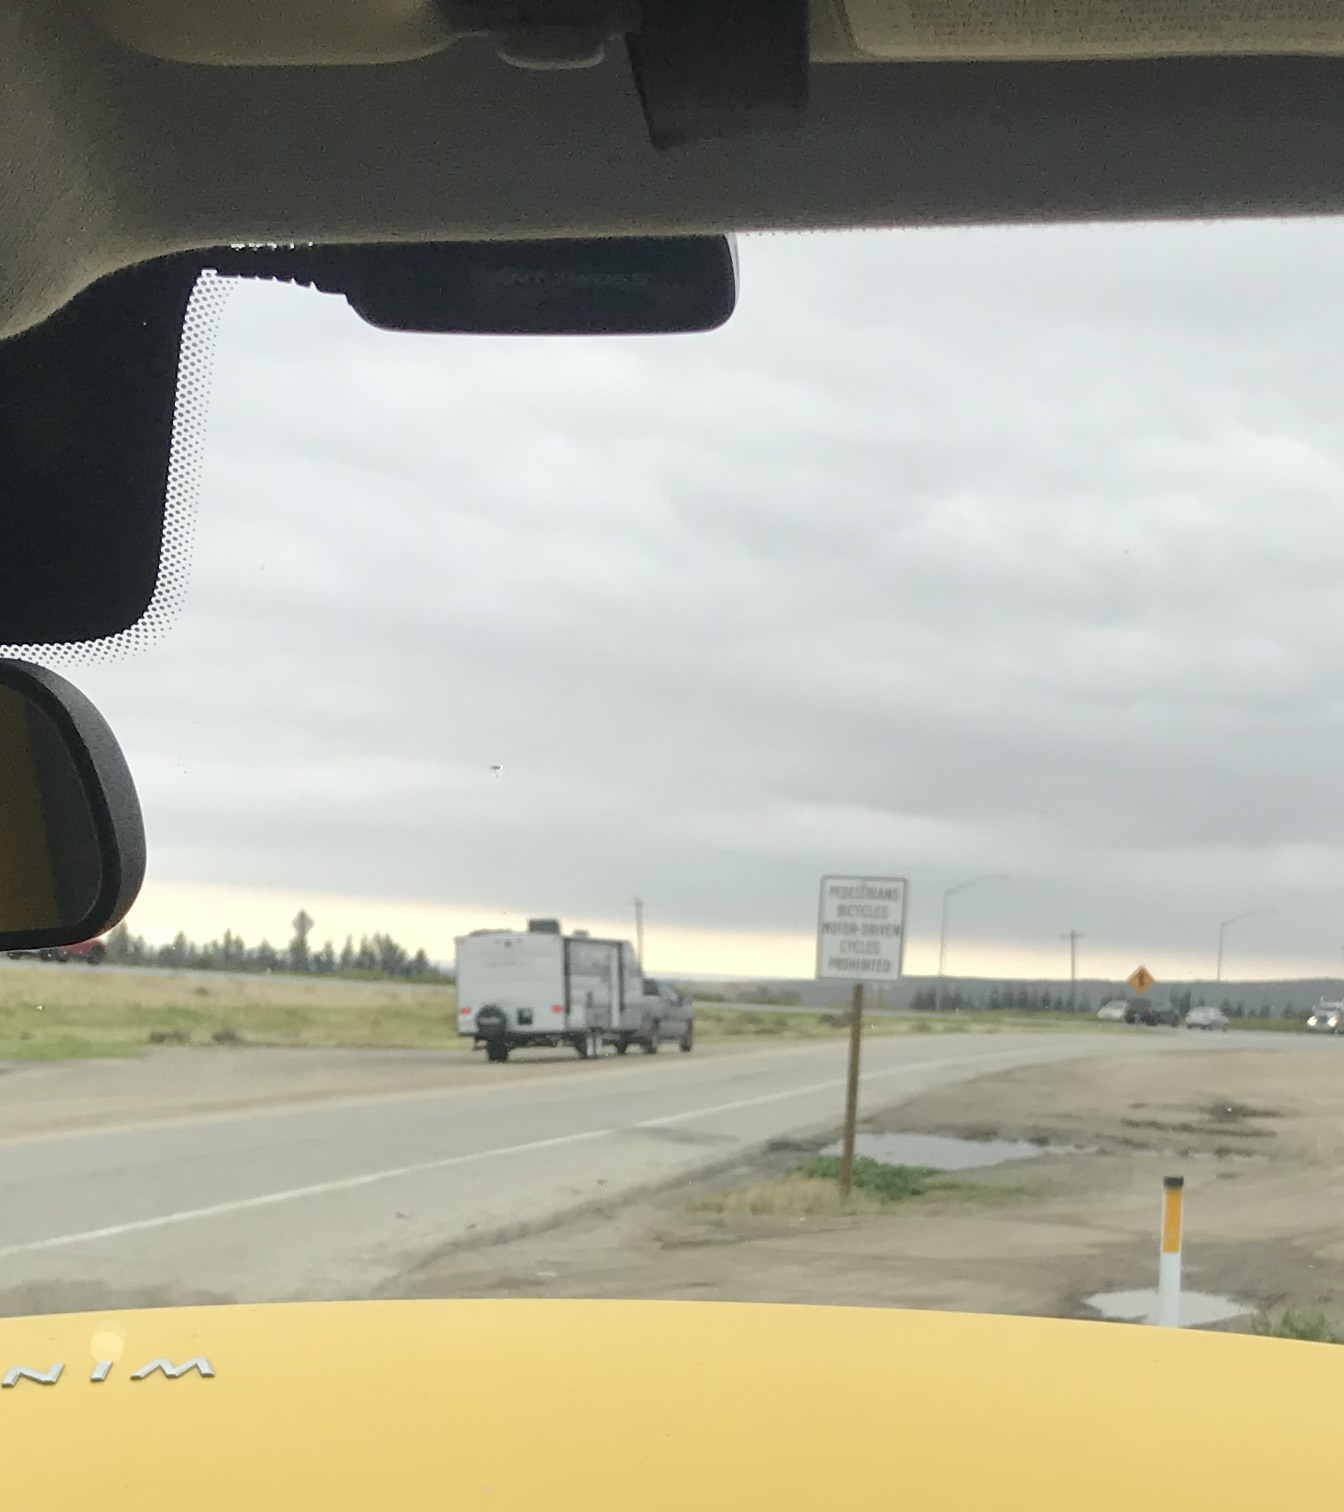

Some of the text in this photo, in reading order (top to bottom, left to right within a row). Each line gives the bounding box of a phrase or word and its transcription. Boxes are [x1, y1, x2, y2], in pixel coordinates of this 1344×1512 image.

[828, 885, 899, 902] PEDESTRIANS
[836, 904, 889, 919] BICYCLES
[822, 921, 900, 937] MOTOR-DRIVEN
[839, 939, 881, 955] CYCLES
[828, 957, 892, 973] PROHIBITED
